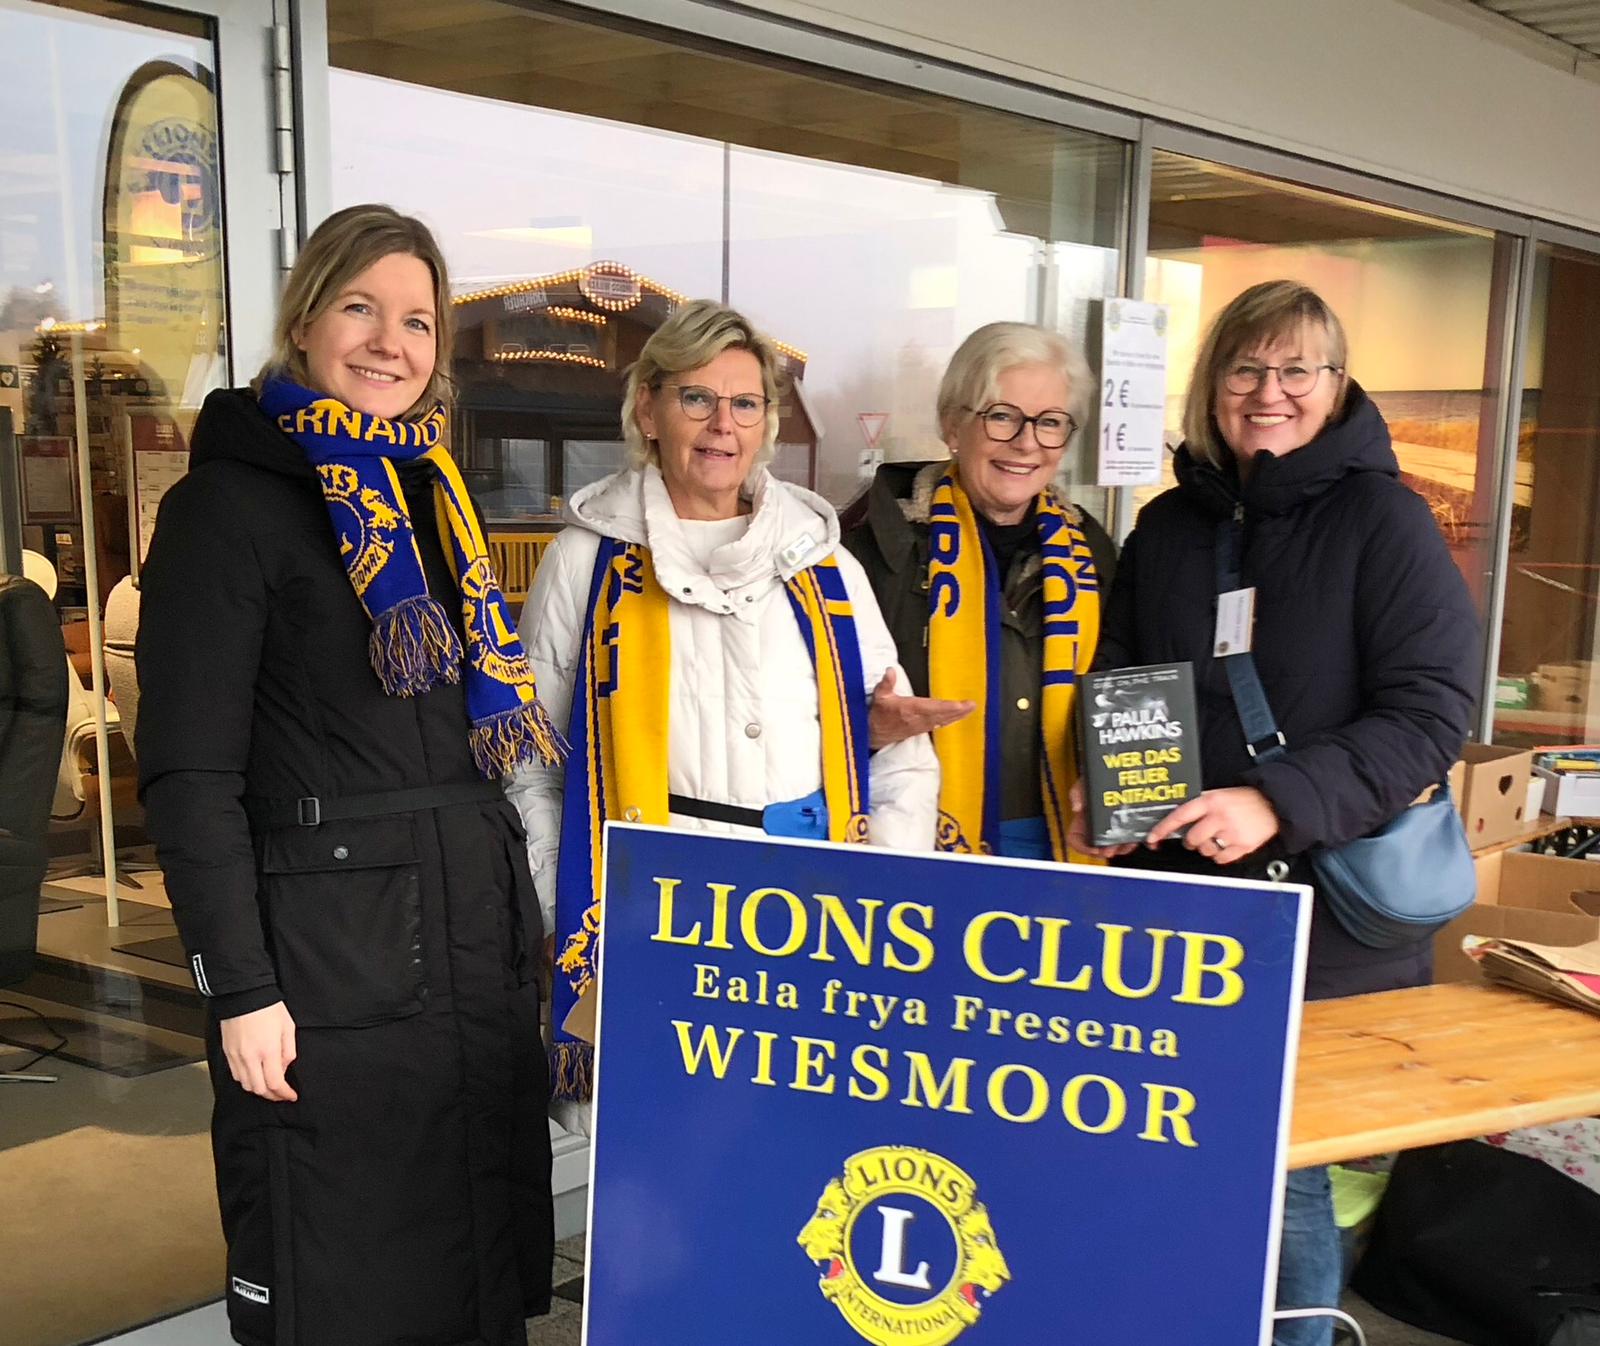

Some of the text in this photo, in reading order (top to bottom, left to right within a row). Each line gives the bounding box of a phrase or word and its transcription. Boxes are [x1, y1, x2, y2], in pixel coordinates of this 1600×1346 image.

[1104, 378, 1115, 408] 2
[1099, 720, 1183, 745] HAWKINS
[1111, 709, 1168, 728] PAULA
[1102, 746, 1182, 769] WER DAS
[1118, 767, 1169, 786] FEUER
[1103, 783, 1188, 807] ENTFACHT
[650, 877, 1245, 1007] LIONS CLUB
[692, 963, 1180, 1058] Eala frya Fresena
[671, 1019, 1199, 1148] WIESMOOR
[857, 1157, 964, 1204] LIONS
[872, 1205, 932, 1290] L
